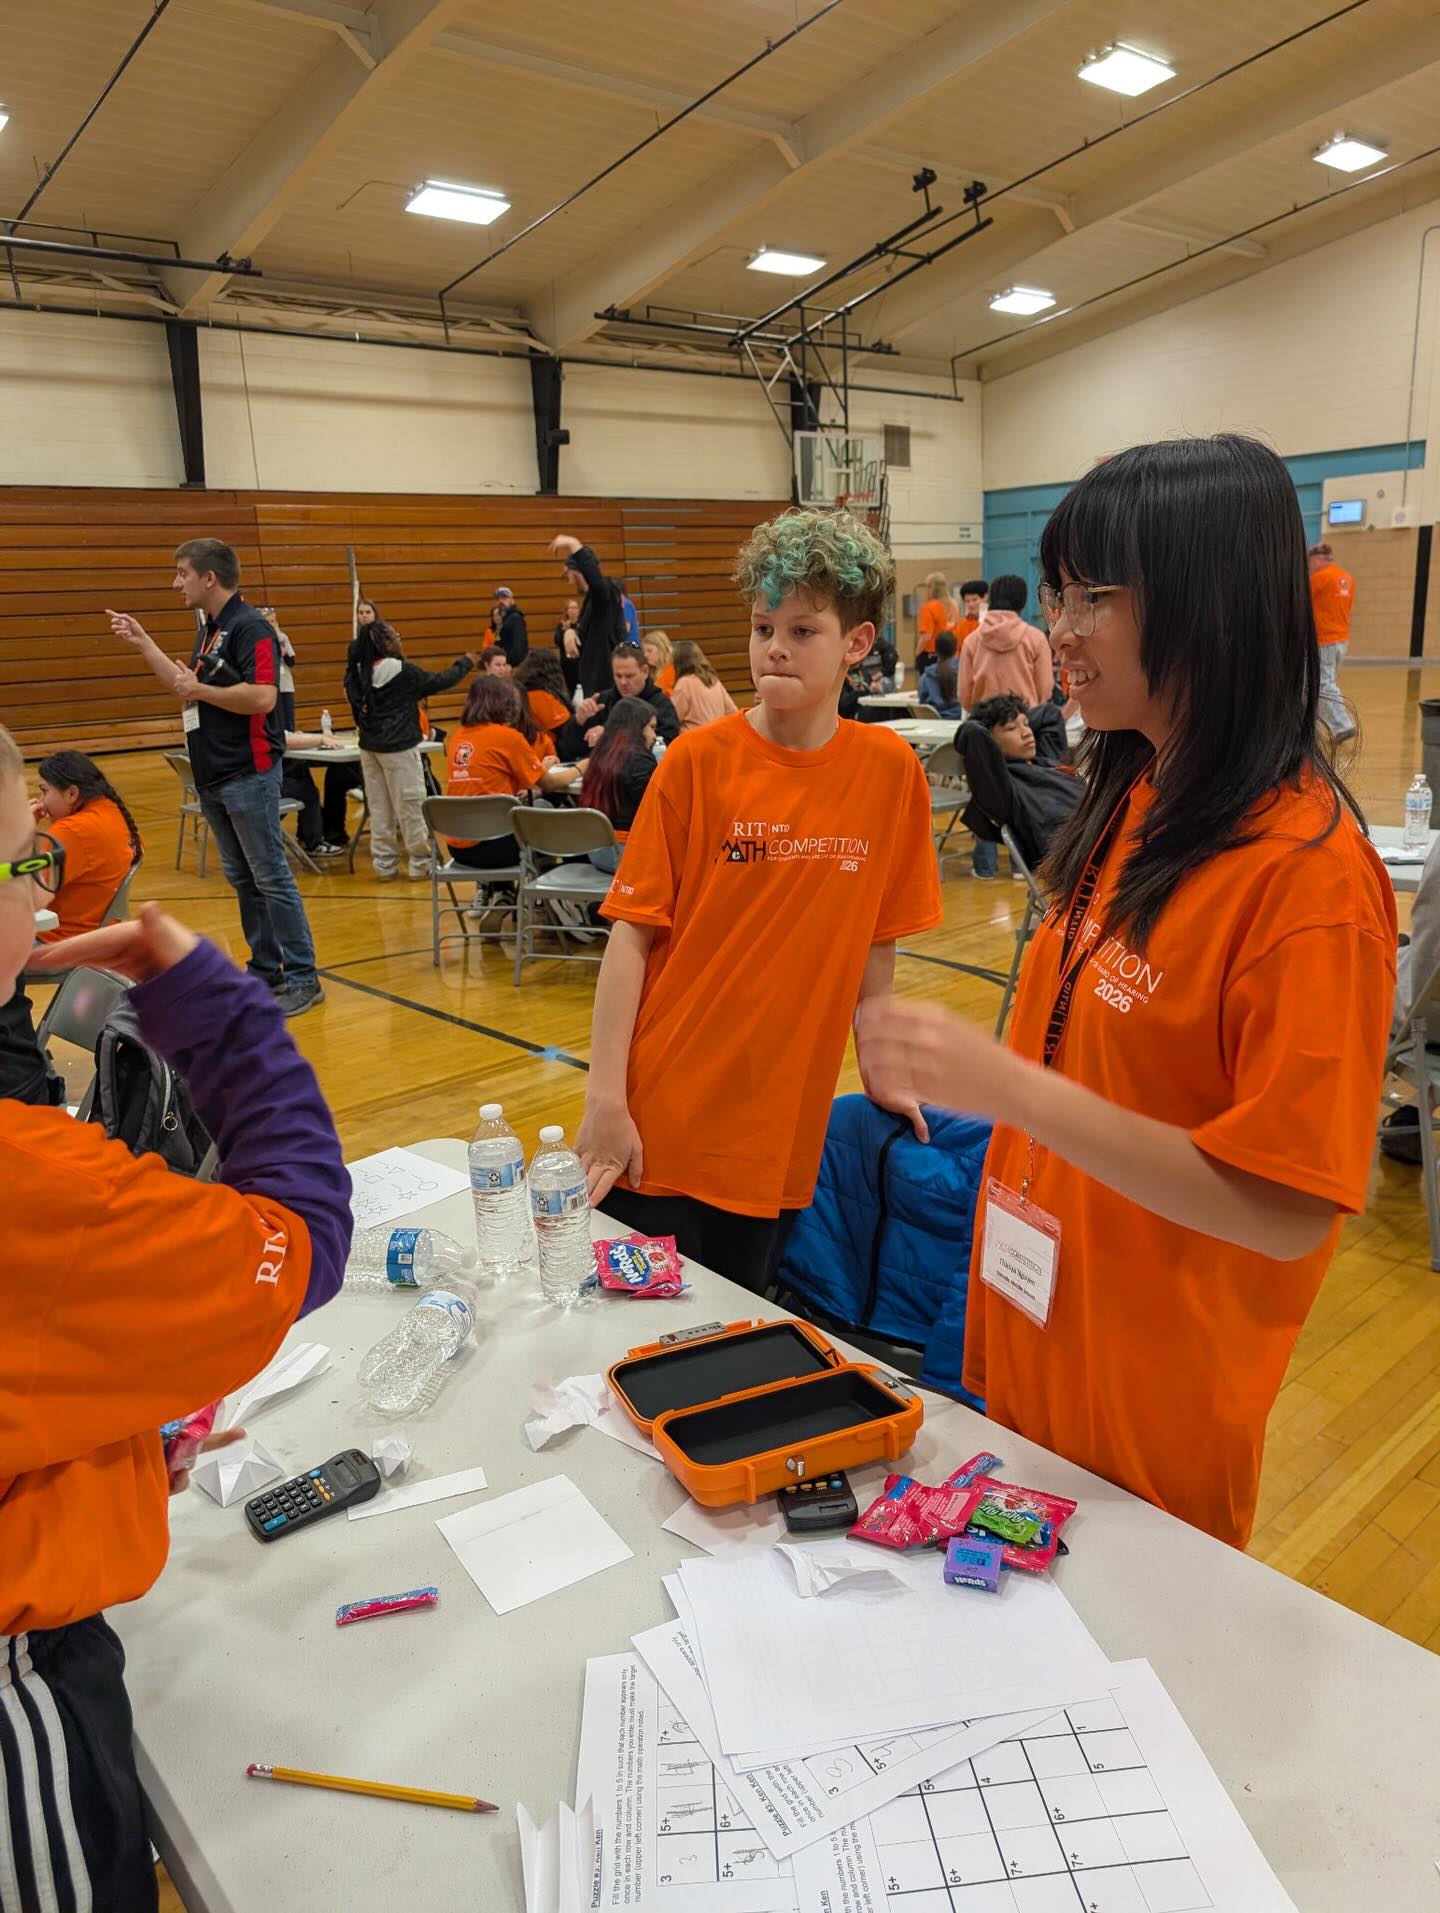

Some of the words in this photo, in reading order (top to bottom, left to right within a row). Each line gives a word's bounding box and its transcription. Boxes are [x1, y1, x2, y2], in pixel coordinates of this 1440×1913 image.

[733, 822, 767, 836] RIT
[769, 837, 869, 855] COMPETITION
[1094, 979, 1133, 1013] 2026
[1118, 982, 1149, 1004] HEARING
[660, 1730, 671, 1742] 7+
[626, 1750, 634, 1778] numbers
[783, 1764, 792, 1775] left
[872, 1757, 887, 1770] 5+
[1092, 1762, 1104, 1770] 5
[745, 1773, 756, 1788] Ken
[765, 1770, 775, 1781] the
[779, 1772, 788, 1784] row
[981, 1776, 992, 1784] 4
[625, 1780, 633, 1793] The
[773, 1781, 783, 1794] with
[786, 1784, 798, 1800] each
[791, 1775, 808, 1795] (upper
[828, 1787, 839, 1795] 3
[755, 1788, 766, 1802] Ken
[781, 1793, 795, 1806] grid
[765, 1802, 774, 1814] #3:
[790, 1805, 800, 1817] the
[804, 1795, 824, 1818] number
[1052, 1807, 1065, 1820] 6+
[720, 1814, 731, 1828] 6+
[804, 1807, 816, 1822] once
[660, 1817, 671, 1831] 5+
[772, 1813, 790, 1837] Puzzle
[796, 1816, 807, 1828] Fill
[833, 1843, 840, 1851] to
[841, 1837, 850, 1851] The
[634, 1846, 643, 1871] (upper
[854, 1844, 863, 1864] using
[1070, 1852, 1082, 1867] 7+
[613, 1862, 622, 1876] grid
[722, 1862, 733, 1878] 5+
[834, 1859, 847, 1890] numbers
[1009, 1860, 1022, 1875] 7+
[857, 1866, 868, 1891] corner)
[948, 1868, 961, 1883] 6+
[887, 1876, 901, 1890] 5+
[591, 1880, 600, 1908] Puzzle
[851, 1883, 859, 1898] and
[612, 1893, 620, 1905] Fill
[841, 1892, 850, 1904] the
[863, 1893, 871, 1905] left
